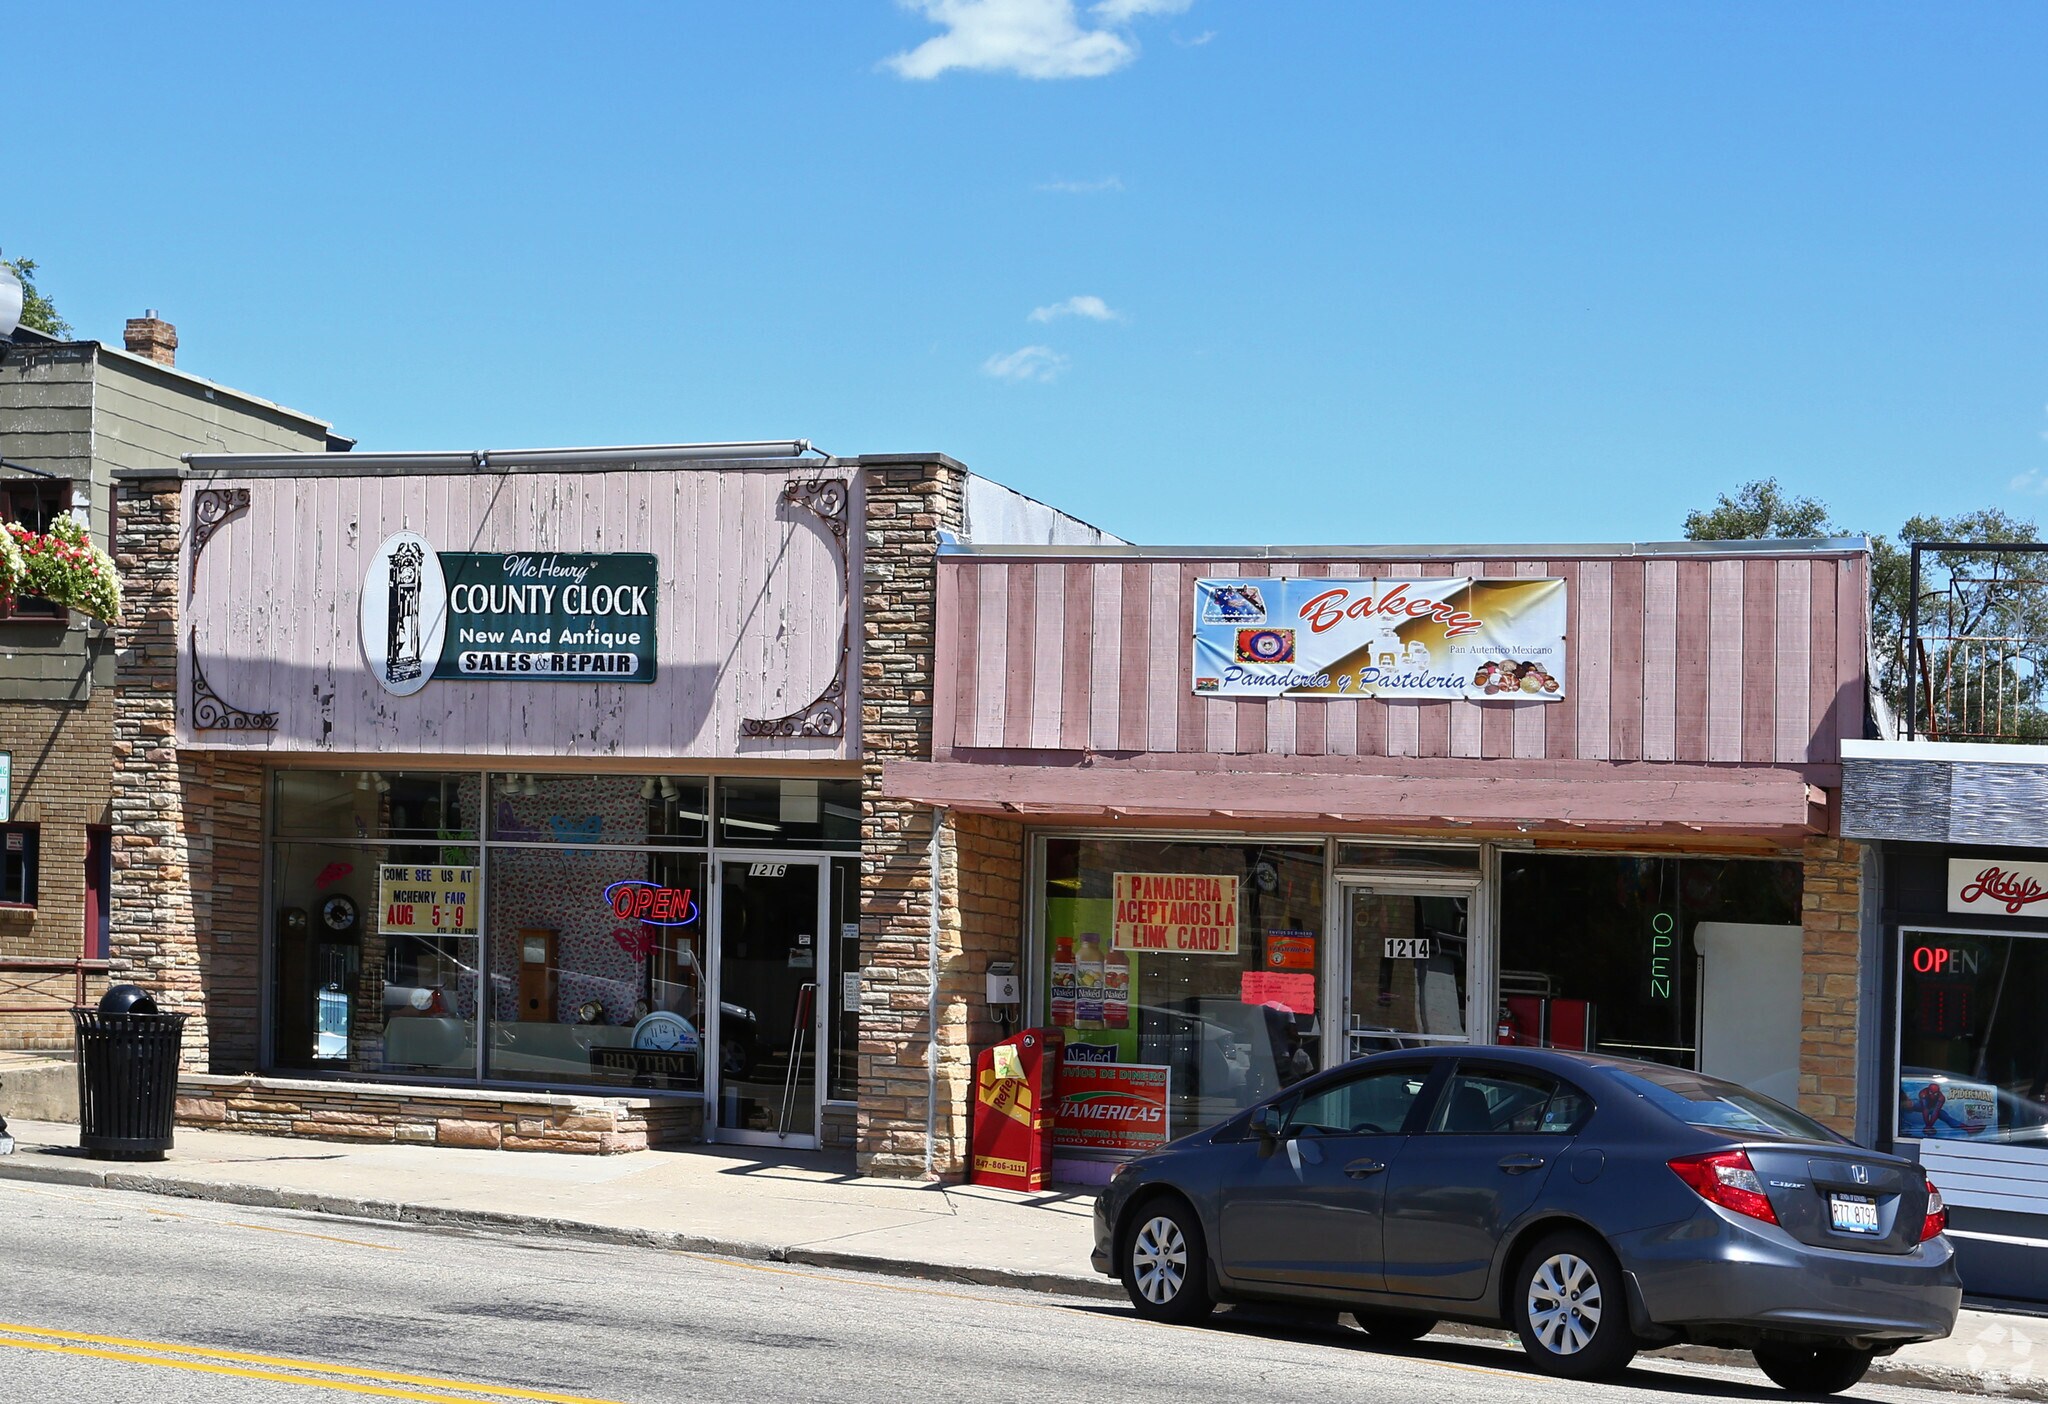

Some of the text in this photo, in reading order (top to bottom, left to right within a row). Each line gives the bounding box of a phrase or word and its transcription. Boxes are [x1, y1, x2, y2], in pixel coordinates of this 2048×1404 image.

[503, 554, 589, 583] McHenry
[450, 583, 649, 616] COUNTY CLOCK
[1299, 583, 1483, 639] Bakery
[459, 627, 641, 648] New And Antique
[1450, 645, 1553, 655] Pan Autentico Mexicano
[465, 653, 631, 673] SALES & REPAIR
[1338, 675, 1351, 693] y
[1360, 667, 1467, 689] Pasteleria
[383, 868, 472, 883] COME SEE US AT
[752, 864, 786, 876] 1216
[393, 890, 466, 905] MCHENRY FAIR
[613, 887, 692, 920] OPEN
[1116, 900, 1235, 927] ACEPTAMOS LA
[1132, 924, 1169, 949] LINK
[1177, 926, 1220, 951] CARD
[1386, 939, 1429, 958] 1214
[1651, 910, 1674, 999] OPEN
[1912, 946, 1979, 975] OPEN
[602, 1053, 685, 1073] RHYTHM
[1067, 1048, 1111, 1063] Naked
[1100, 1069, 1116, 1079] DE
[1119, 1070, 1166, 1081] DINERO
[975, 1157, 1026, 1173] 847-806-1111
[1832, 1203, 1878, 1226] R77 8792
